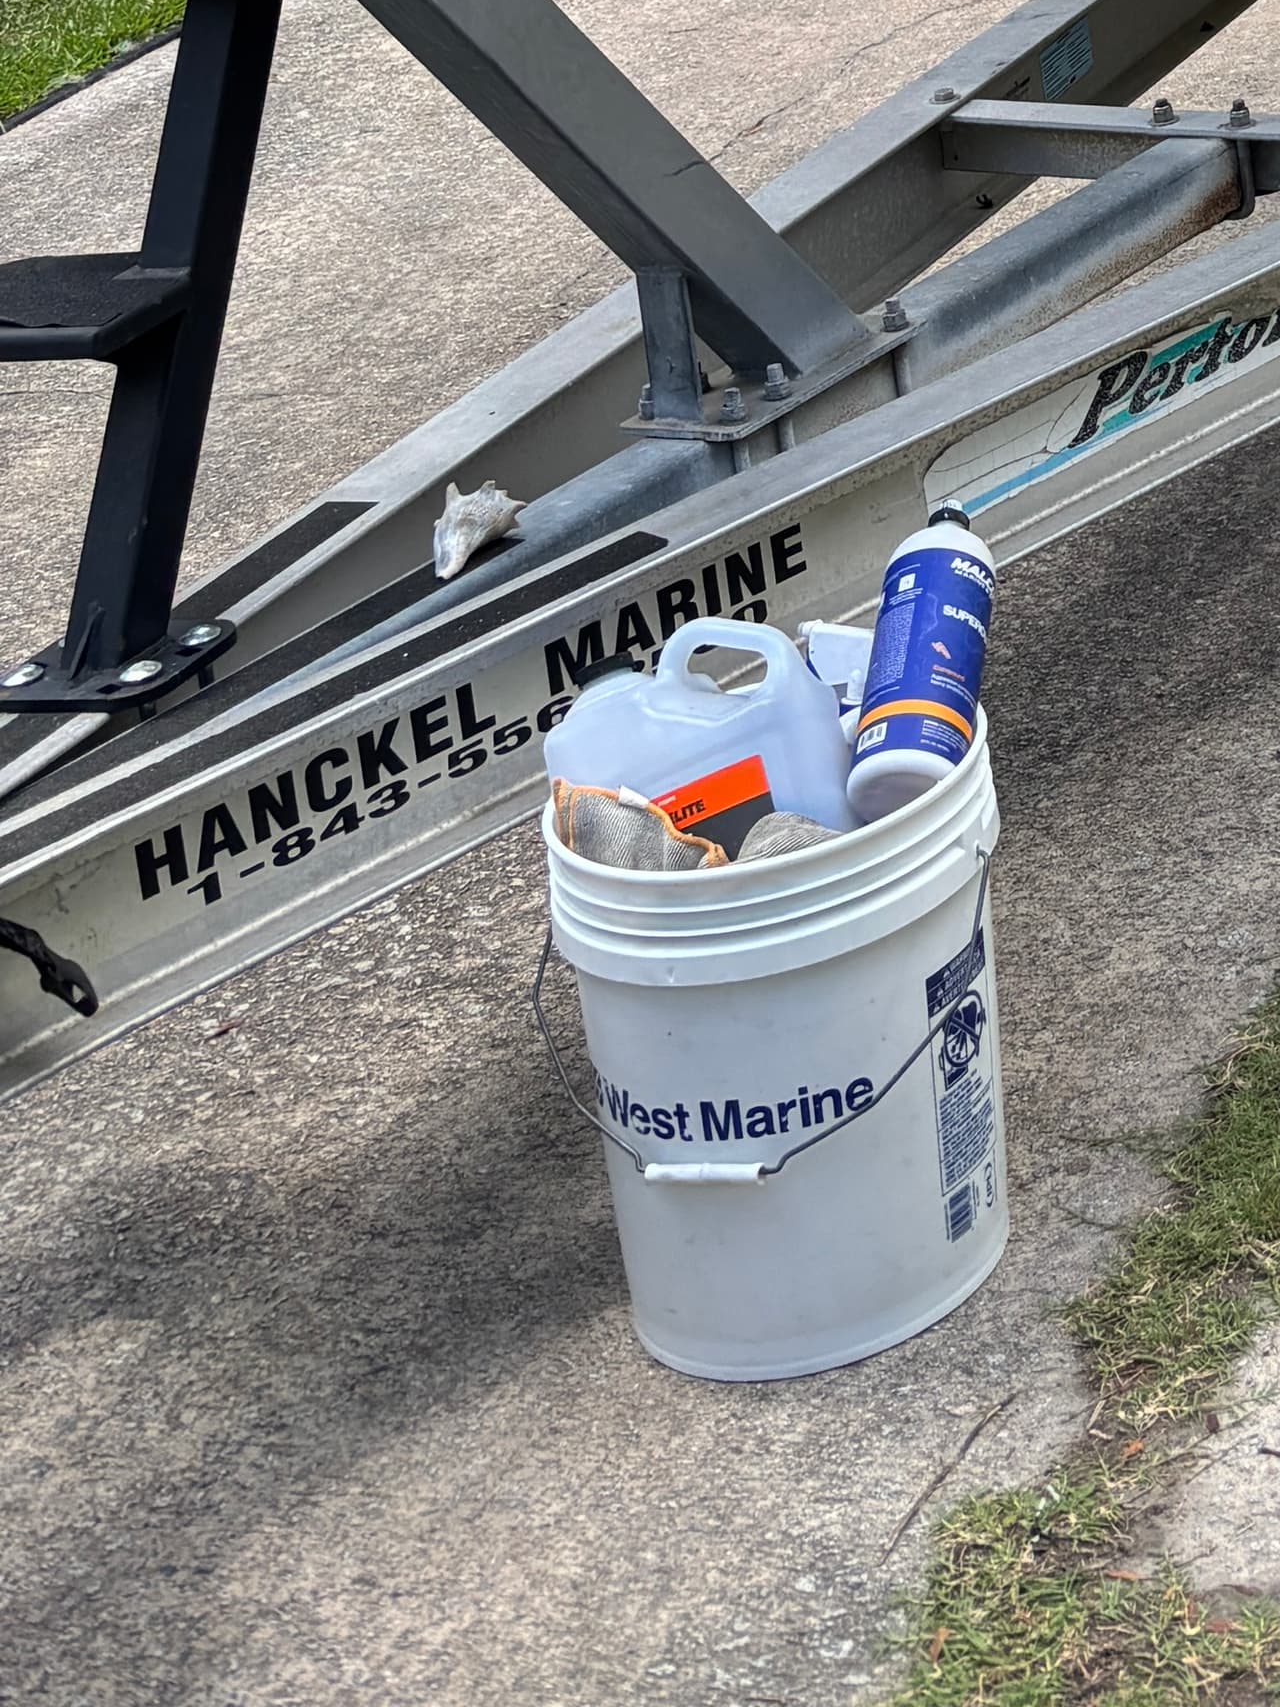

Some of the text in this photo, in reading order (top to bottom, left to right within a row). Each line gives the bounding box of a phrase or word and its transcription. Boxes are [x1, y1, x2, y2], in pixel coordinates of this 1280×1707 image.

[134, 682, 496, 901] HANCKEL
[544, 522, 807, 697] MARINE
[602, 1075, 694, 1142] West
[699, 1076, 874, 1142] Marine
